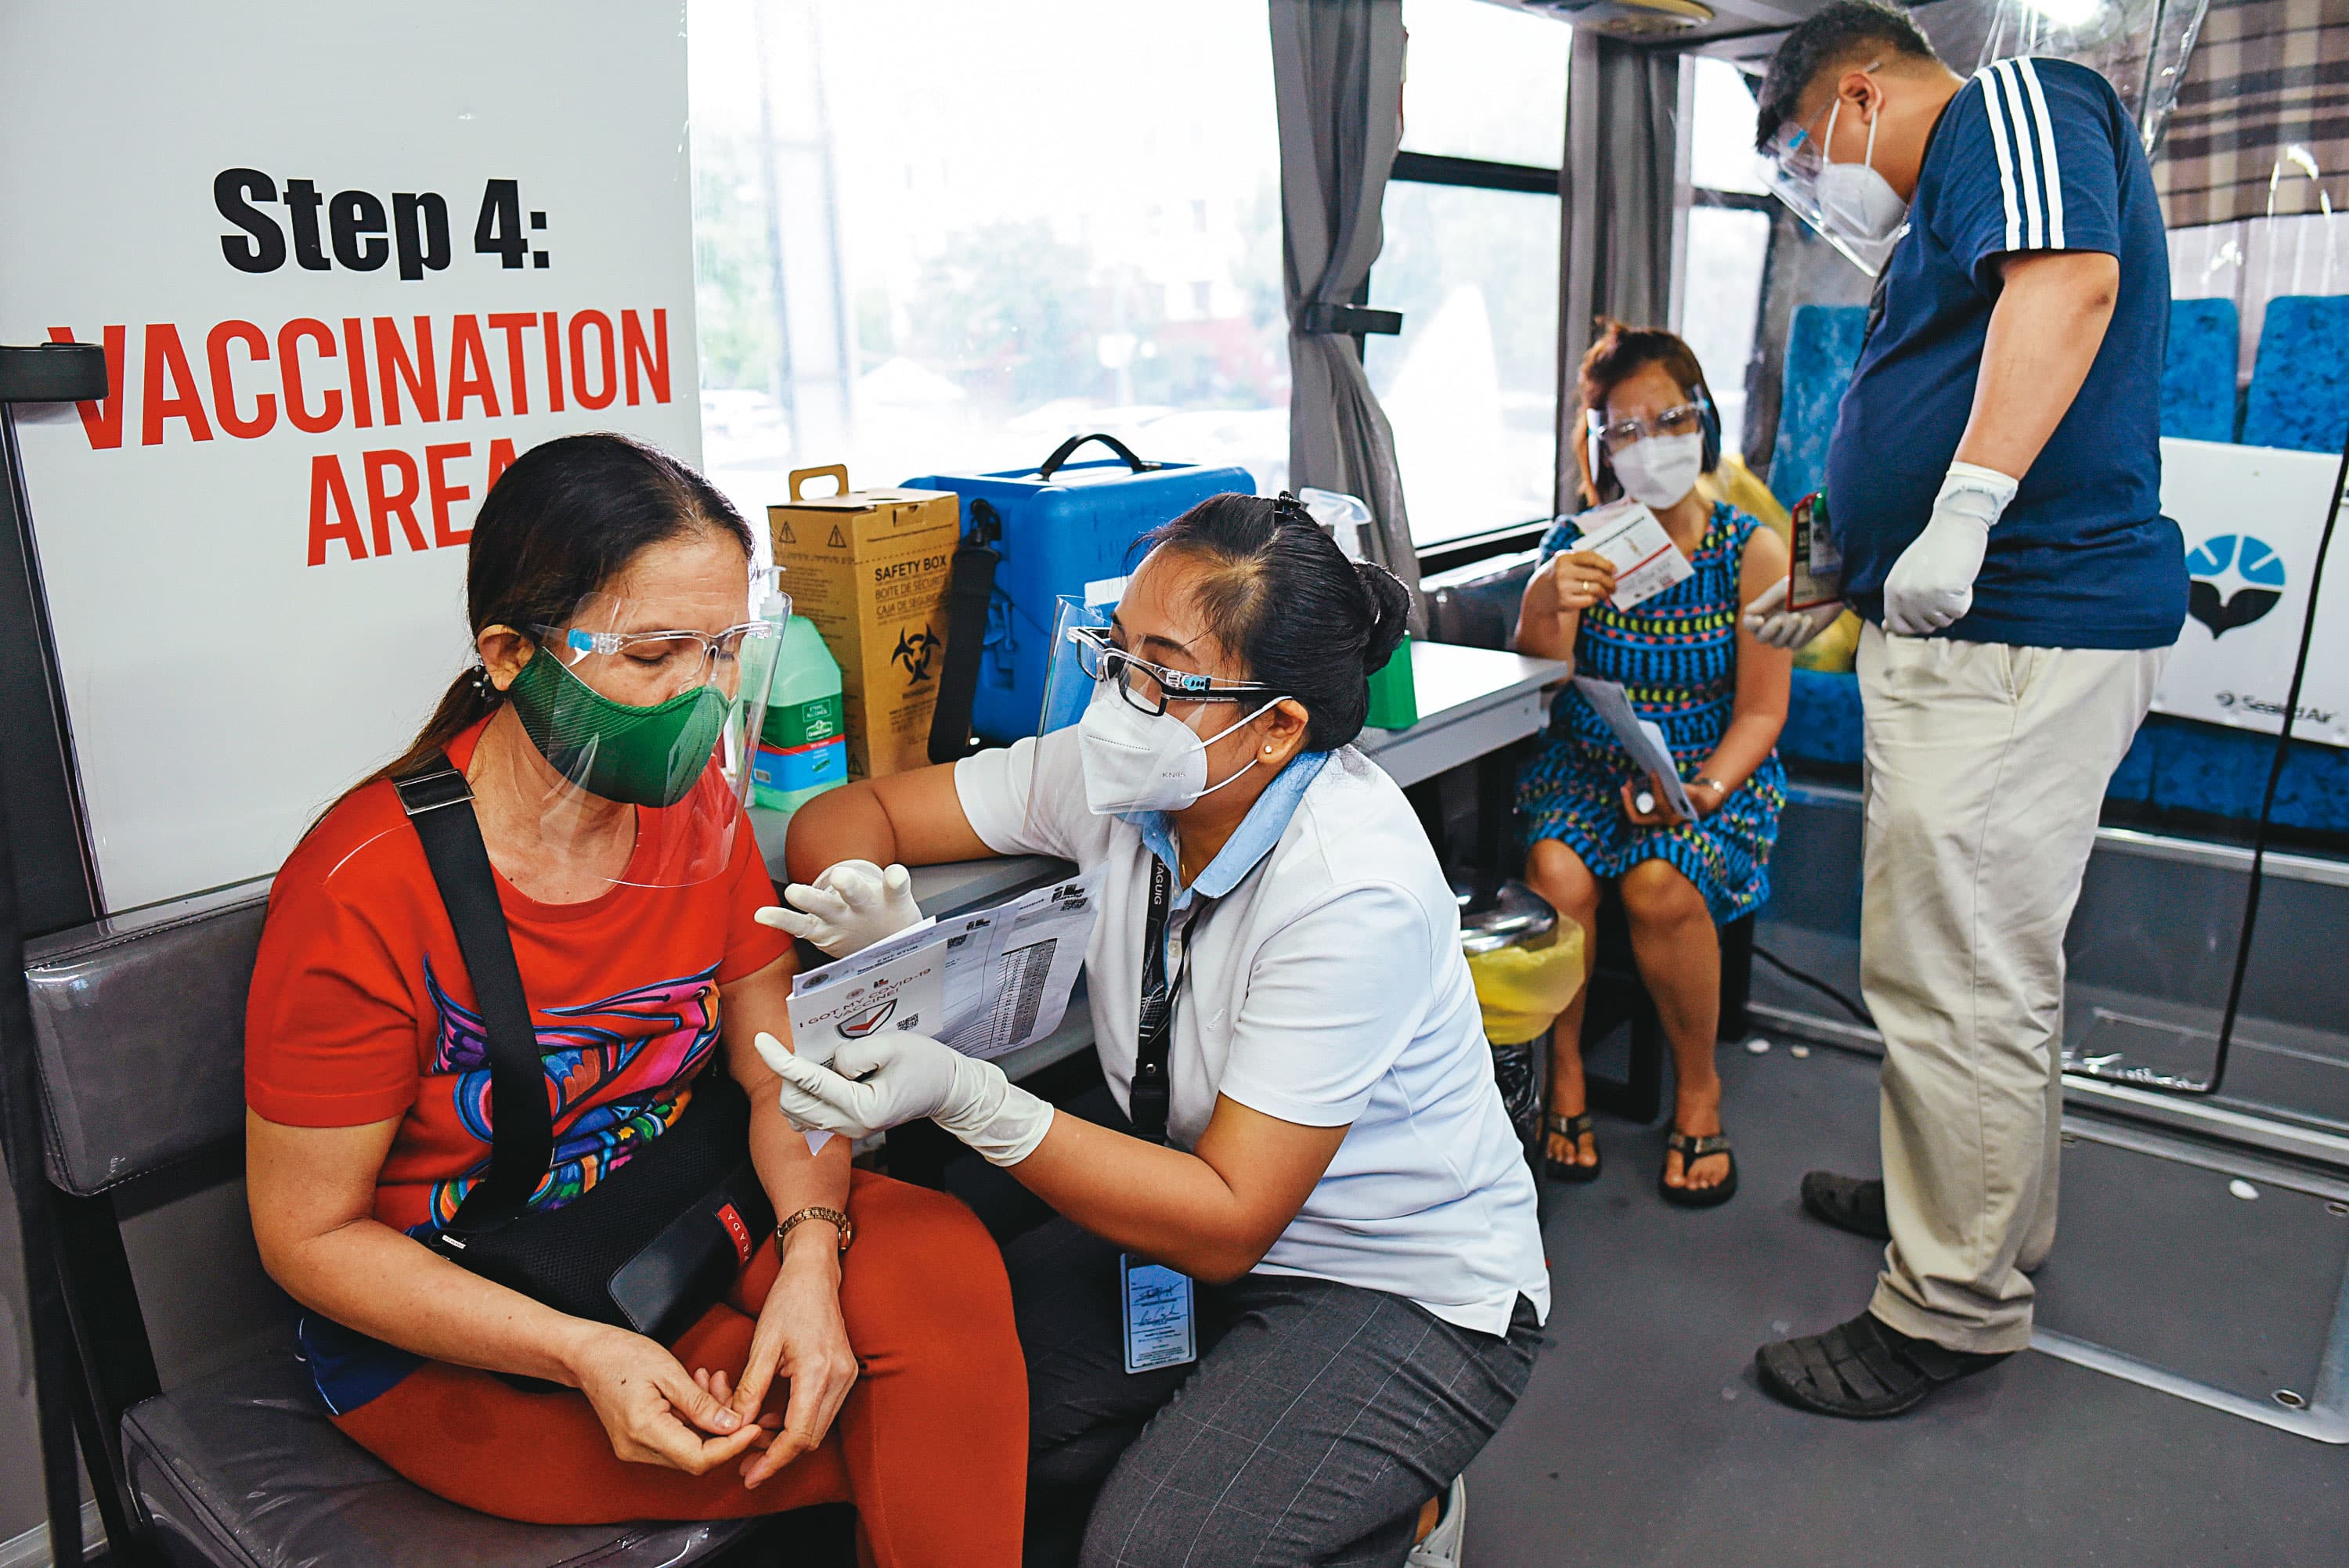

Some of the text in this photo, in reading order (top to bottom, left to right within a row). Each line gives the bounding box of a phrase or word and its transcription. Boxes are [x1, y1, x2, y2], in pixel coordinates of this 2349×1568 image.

[213, 168, 550, 281] Step 4:
[47, 308, 673, 450] VACCINATION
[307, 438, 517, 568] ARE
[875, 559, 921, 581] SAFETY
[923, 554, 947, 571] BOX
[1153, 862, 1164, 906] TAGUIG
[808, 1007, 840, 1026] GOT
[843, 997, 864, 1011] MY
[868, 968, 932, 999] COVID-19
[834, 987, 900, 1020] VACCINE!
[727, 1213, 749, 1262] PRADA
